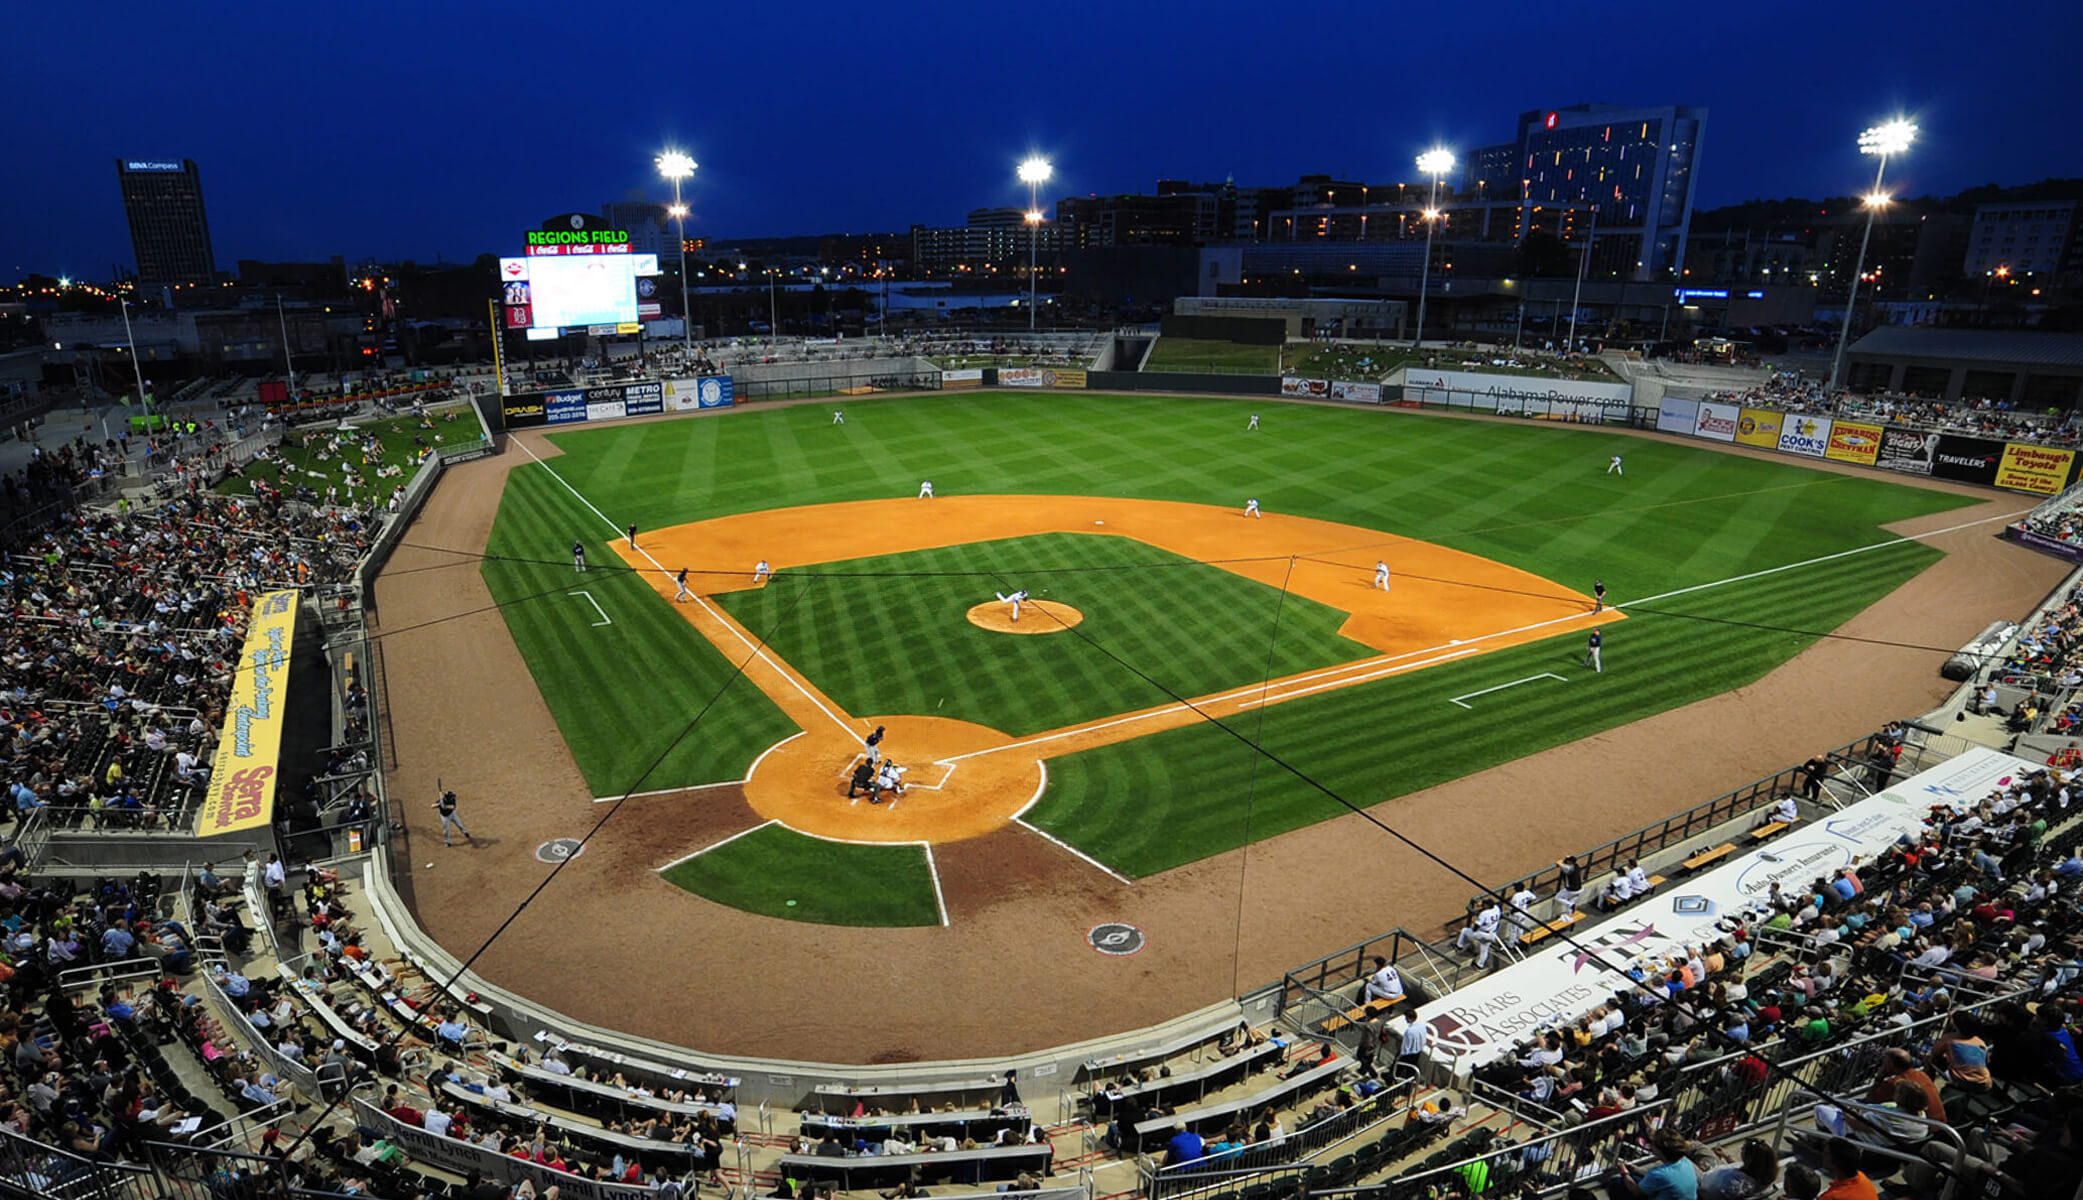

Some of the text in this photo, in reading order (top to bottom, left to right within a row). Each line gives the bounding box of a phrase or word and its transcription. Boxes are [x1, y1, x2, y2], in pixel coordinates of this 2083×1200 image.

[528, 230, 628, 245] REGIONS FIELD
[588, 388, 621, 400] century
[626, 384, 660, 395] METRO
[1486, 385, 1626, 409] AlabamaPower.com
[555, 393, 583, 404] Budget
[504, 404, 544, 416] DRASH
[1780, 433, 1825, 450] COOK'S
[1833, 426, 1880, 442] EDWARDS
[1794, 445, 1822, 455] CONTROL
[2008, 447, 2070, 463] Limbaugh
[1938, 454, 1986, 469] TRAVELERS
[2015, 457, 2057, 470] Toyota
[232, 765, 274, 822] Serra
[214, 781, 234, 829] Chevrolet
[1743, 843, 1840, 895] Auto-Owners Insurance
[1449, 991, 1523, 1028] BYARS
[1481, 983, 1593, 1044] ASSOCIATES
[437, 1139, 482, 1163] Lynch
[539, 1171, 594, 1198] Merrill
